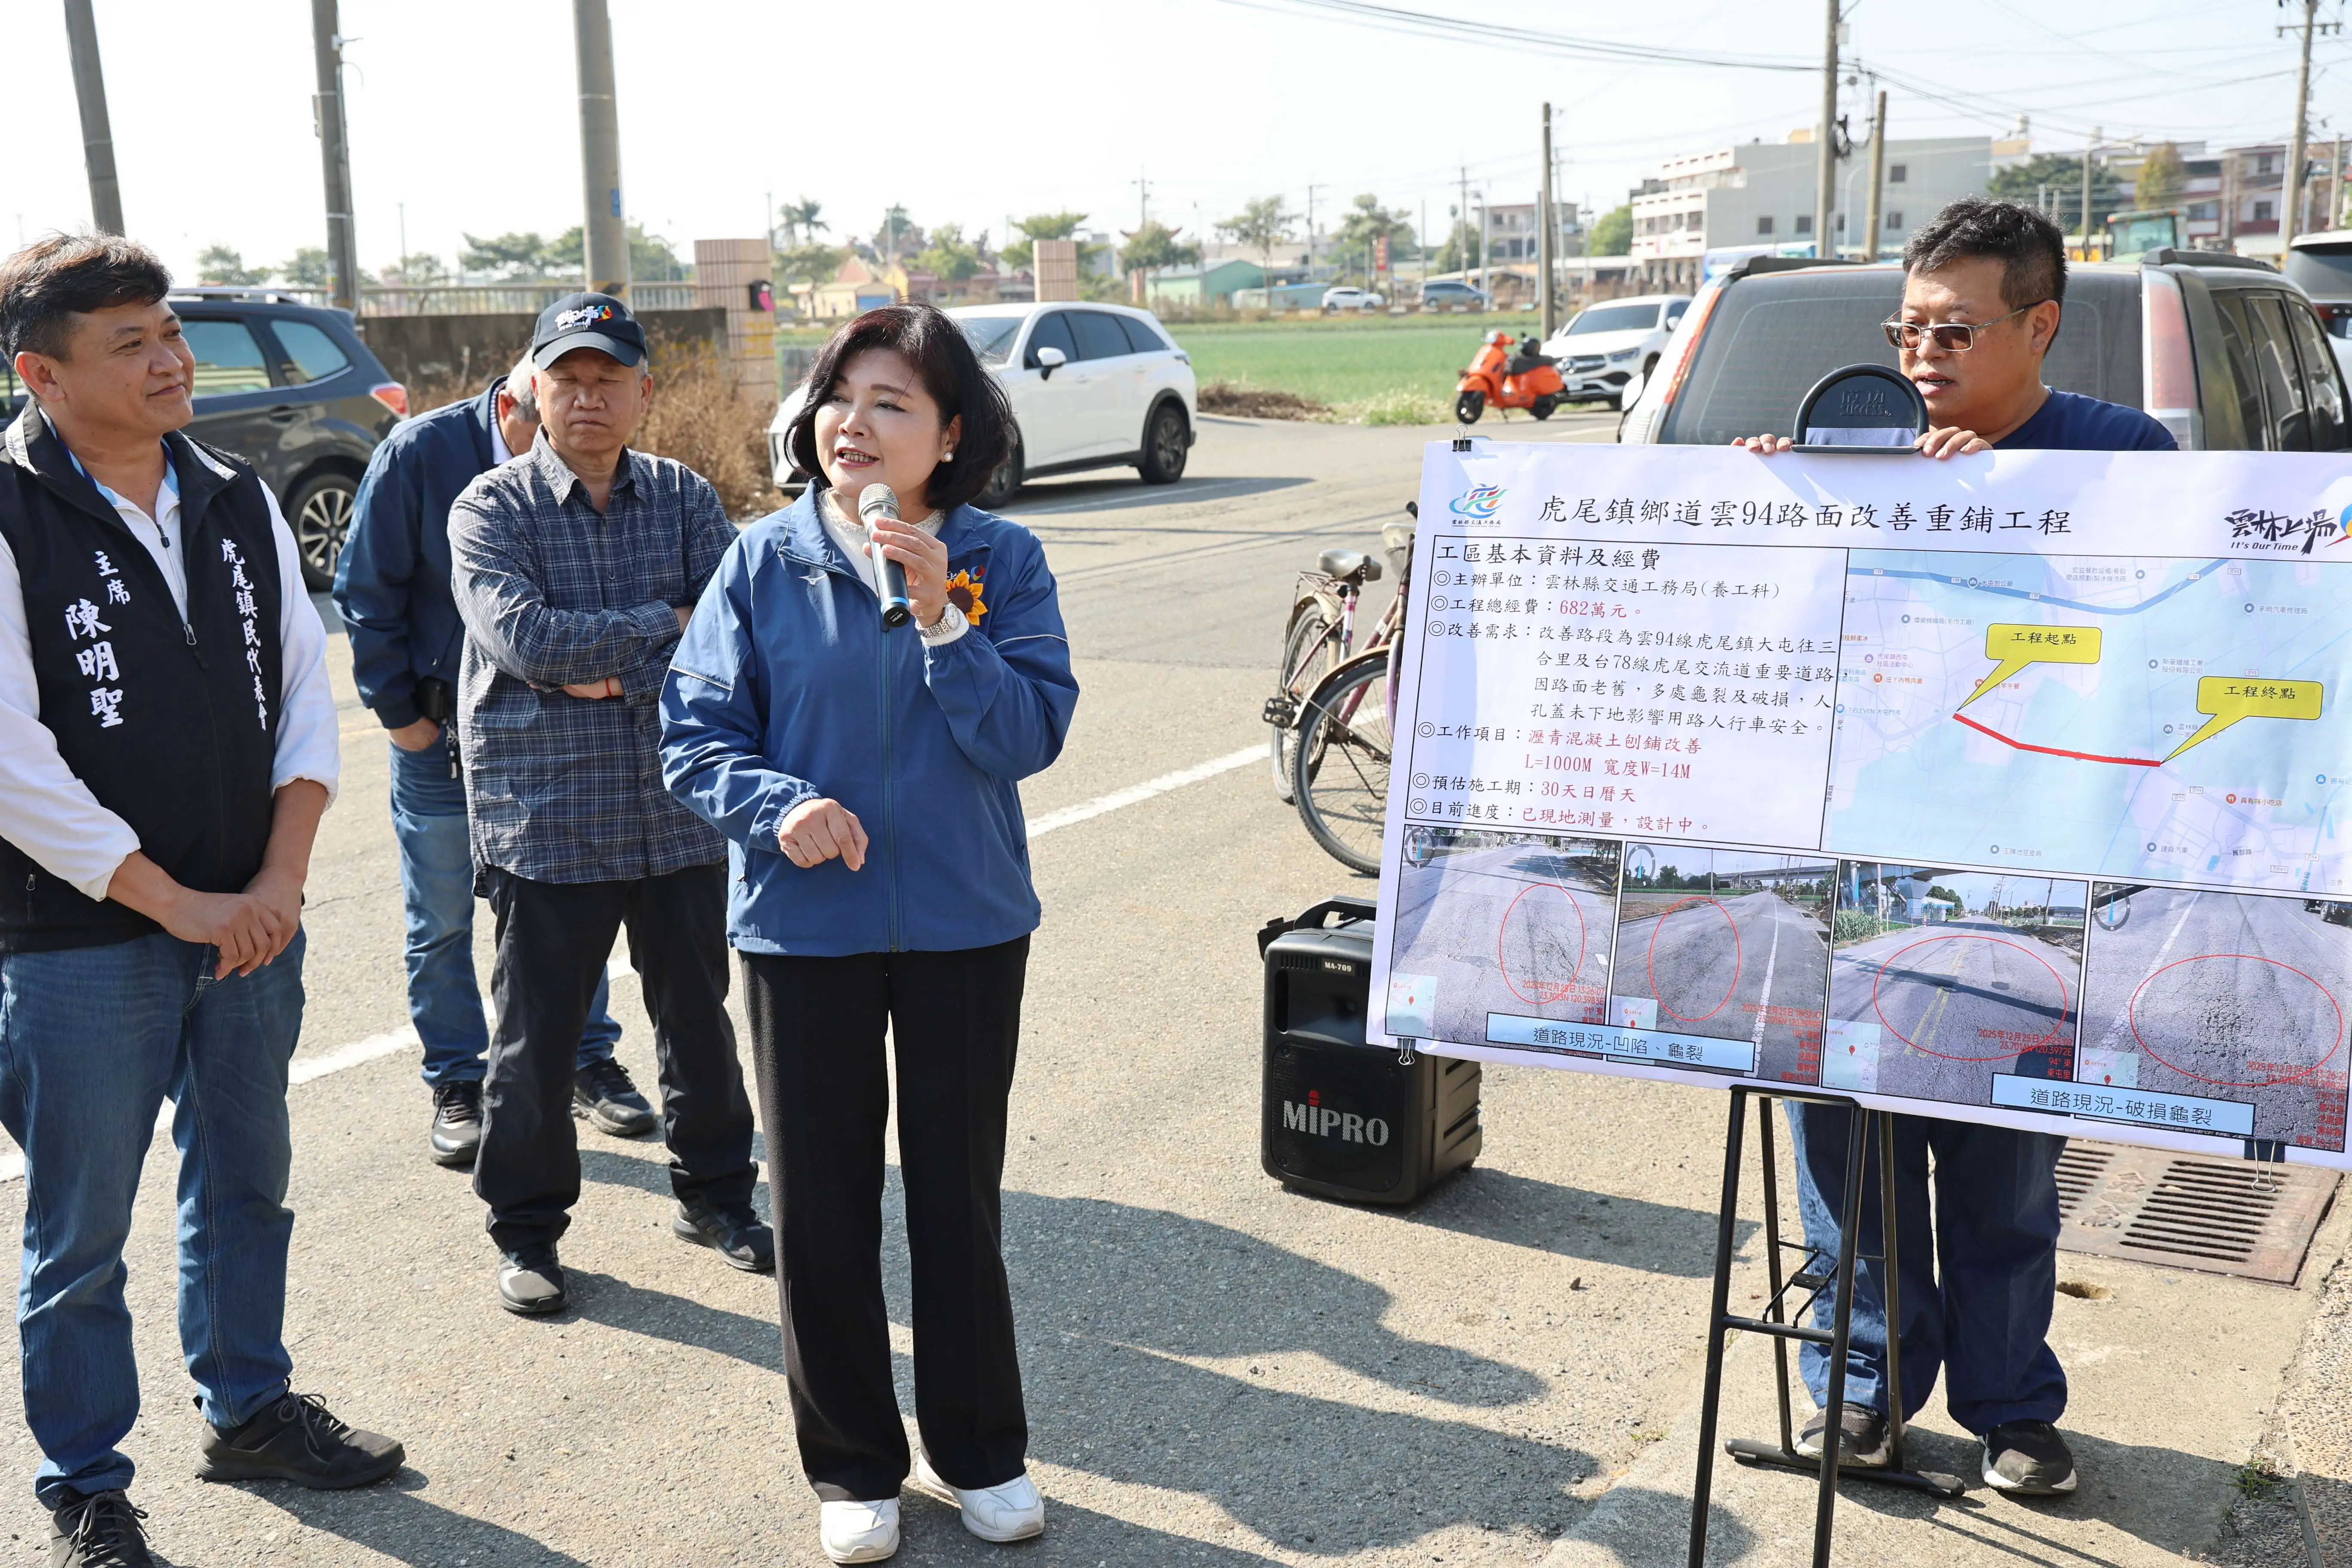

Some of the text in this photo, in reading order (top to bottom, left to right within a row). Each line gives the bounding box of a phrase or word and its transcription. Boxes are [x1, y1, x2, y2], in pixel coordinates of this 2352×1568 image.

[1538, 495, 2073, 536] 虎尾鎮鄉道雲94路面改善重鋪工程
[2224, 508, 2337, 556] 雲林上場
[1436, 543, 1660, 570] 工區基本資料及經費
[2252, 542, 2271, 550] Our
[2274, 542, 2298, 551] Time
[95, 551, 131, 605] 主席
[221, 538, 267, 731] 虎尾鎮民代表會
[2010, 632, 2076, 645] 工程起點
[65, 598, 124, 728] 陳明聖
[2224, 686, 2295, 699] 工程終點
[1525, 753, 1592, 773] L=1000M
[2241, 797, 2282, 806] 真有味小吃店
[1324, 961, 1352, 973] MA-709
[1533, 1027, 1703, 1062] 道路現況-凹陷、龜裂
[2047, 1068, 2071, 1079] 東屯里
[2064, 1059, 2072, 1067] 東
[2030, 1088, 2212, 1127] 道路現況-破損龜裂
